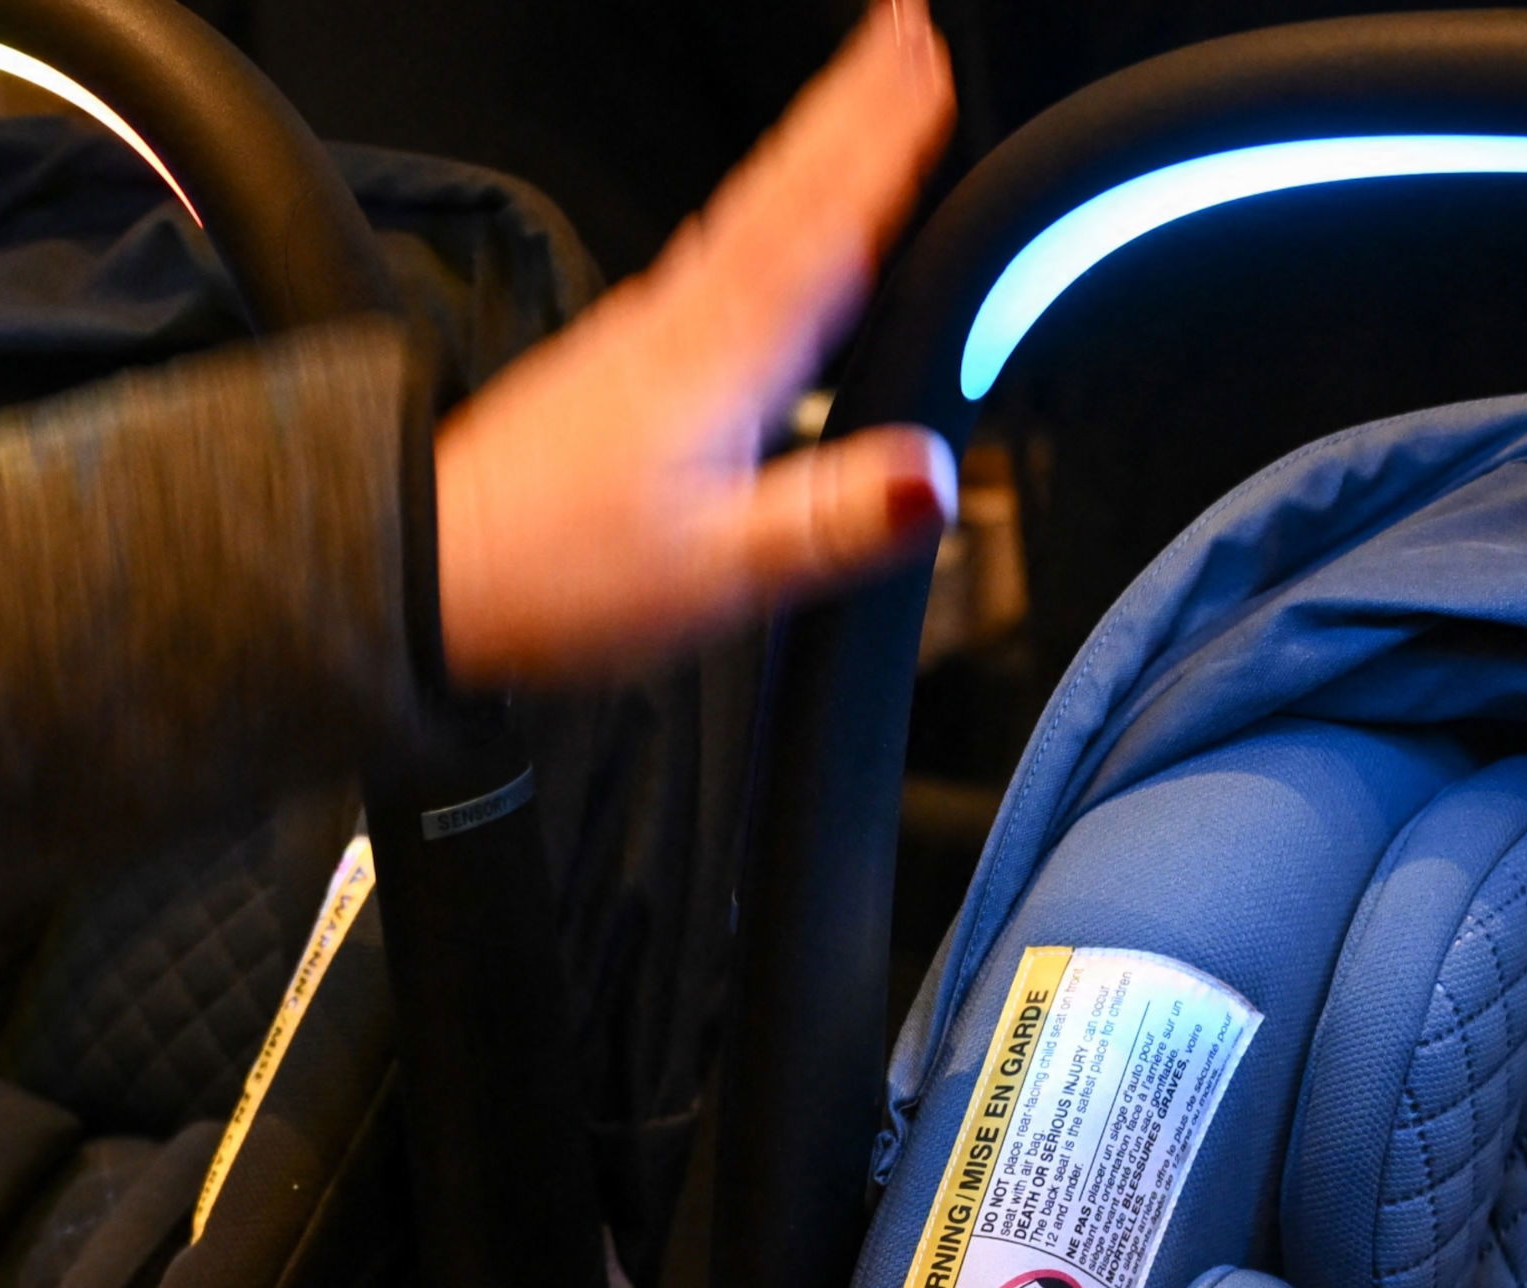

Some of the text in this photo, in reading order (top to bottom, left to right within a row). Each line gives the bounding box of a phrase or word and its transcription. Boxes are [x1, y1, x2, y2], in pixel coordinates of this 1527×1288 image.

[980, 965, 1084, 1236] DO NOT place rear-facing child seat on front
[985, 1079, 1015, 1121] EN
[999, 984, 1049, 1080] GARDE
[1014, 983, 1111, 1241] DEATH OR SERIOUS INJURY can occur
[1029, 968, 1134, 1246] The back seat is the safest place for children
[1065, 1031, 1156, 1259] NE PAS placer un siège d'auto pour
[1077, 999, 1183, 1266] enfant en orientation face à l'arrière sur un
[1121, 1234, 1141, 1271] siège
[1135, 1189, 1158, 1234] arrière
[1153, 1157, 1171, 1189] offre
[1165, 1143, 1177, 1156] le
[1171, 1113, 1189, 1143] plus
[1184, 1094, 1197, 1112] de
[1192, 1042, 1220, 1093] sécurité
[1215, 1011, 1234, 1042] pour
[999, 1127, 1047, 1237] seat with air bag.
[1045, 1161, 1084, 1250] 12 and under.
[1086, 1045, 1180, 1272] siège avant doté d'un sac gonflable.
[1095, 1022, 1204, 1278] Risque de BLESSURES GRAVES, voire
[1104, 1191, 1146, 1284] MORTELLES.
